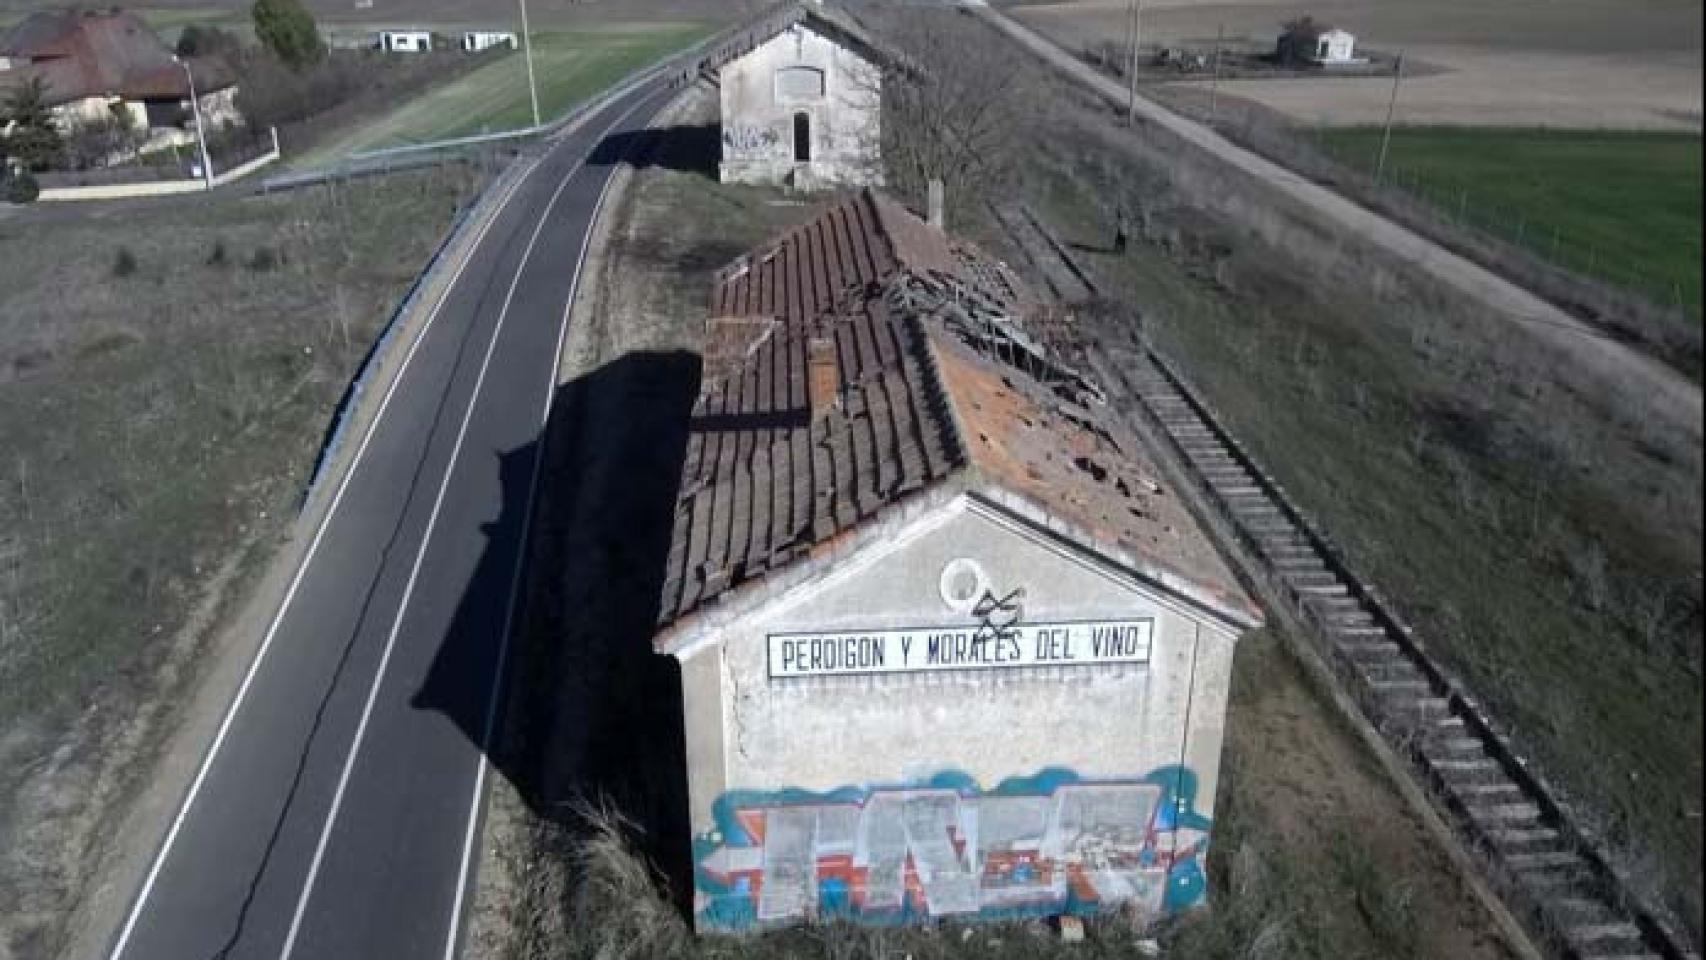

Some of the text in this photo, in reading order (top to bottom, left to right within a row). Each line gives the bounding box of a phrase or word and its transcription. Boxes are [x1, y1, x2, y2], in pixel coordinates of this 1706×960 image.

[782, 625, 1139, 672] PERDIGON Y MORALES DEL VINO
